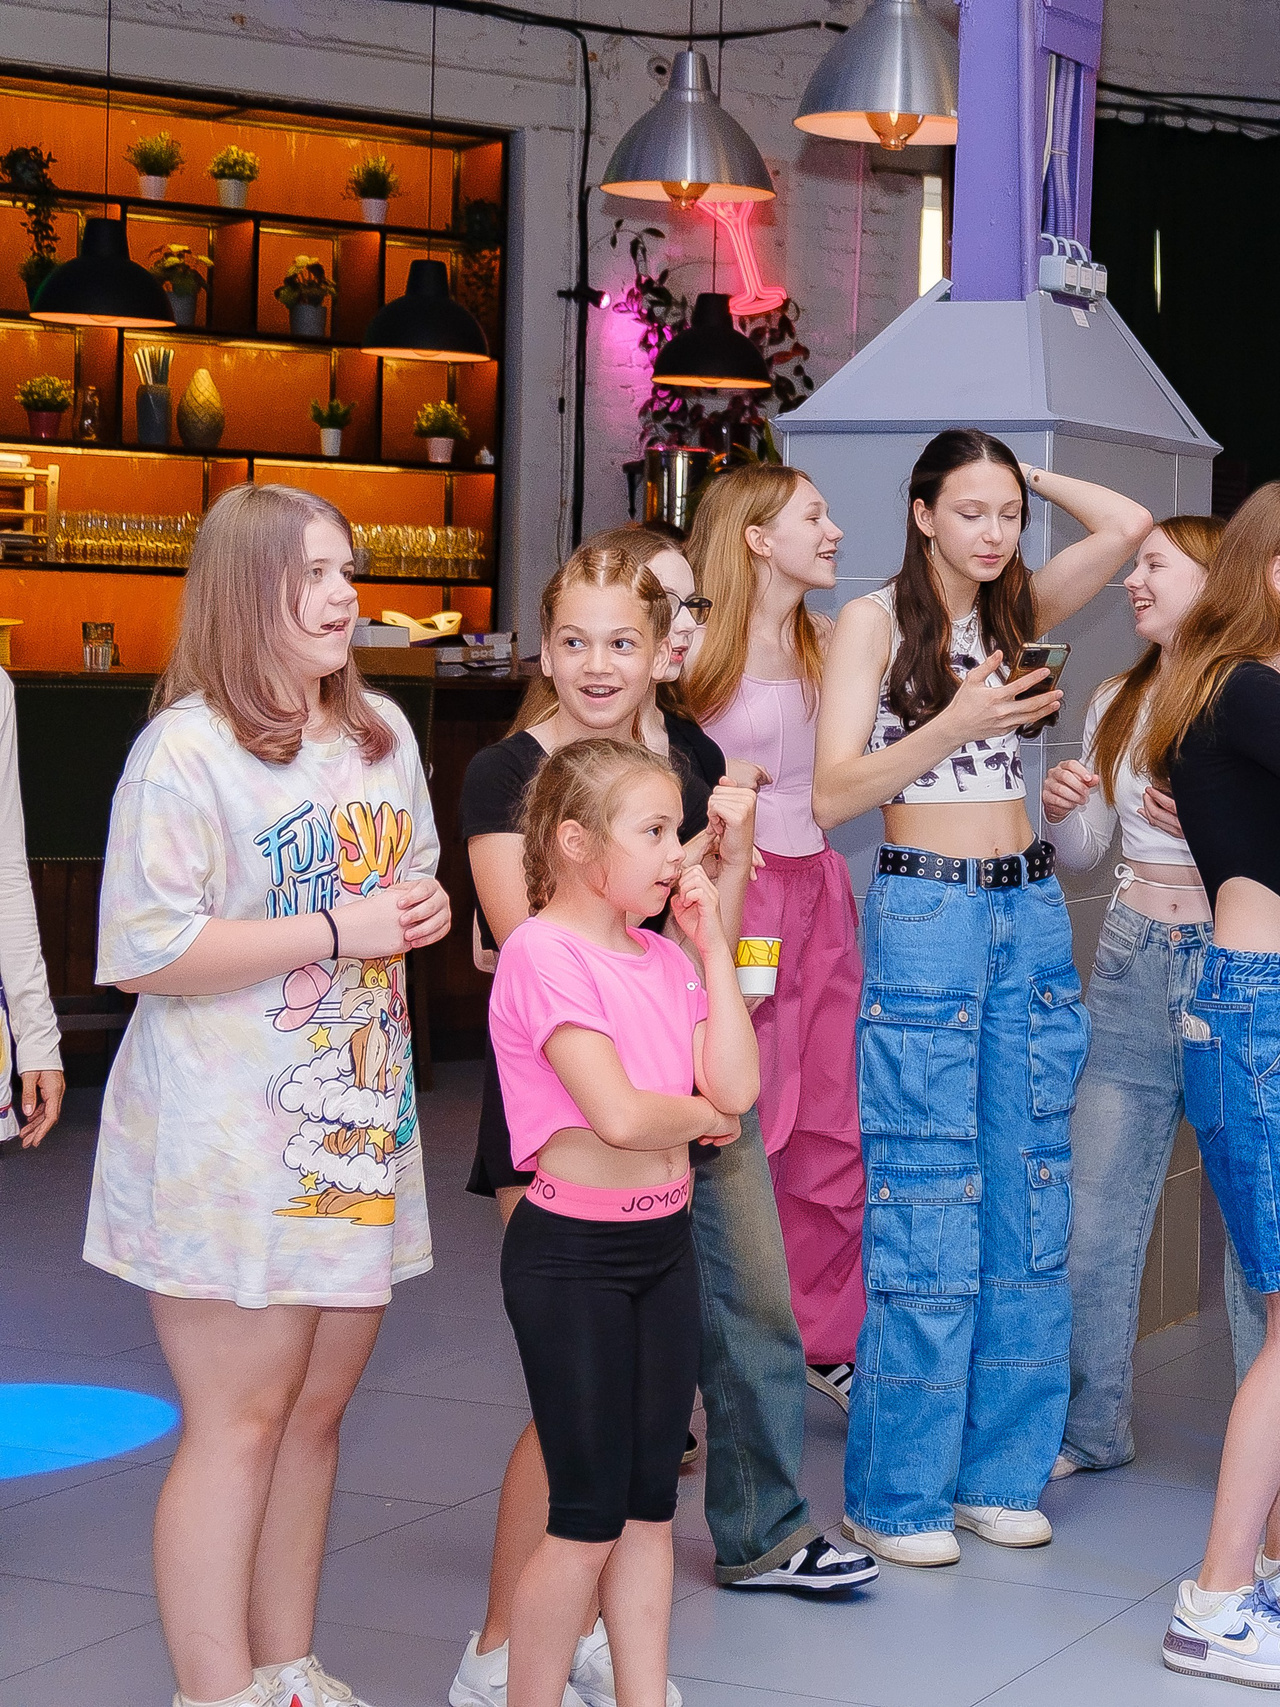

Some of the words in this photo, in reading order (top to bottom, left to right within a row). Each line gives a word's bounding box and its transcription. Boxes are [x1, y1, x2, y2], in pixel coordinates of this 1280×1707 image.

[253, 800, 335, 886] FUN
[330, 801, 412, 894] SUN
[266, 876, 298, 919] IN
[297, 862, 341, 914] TH
